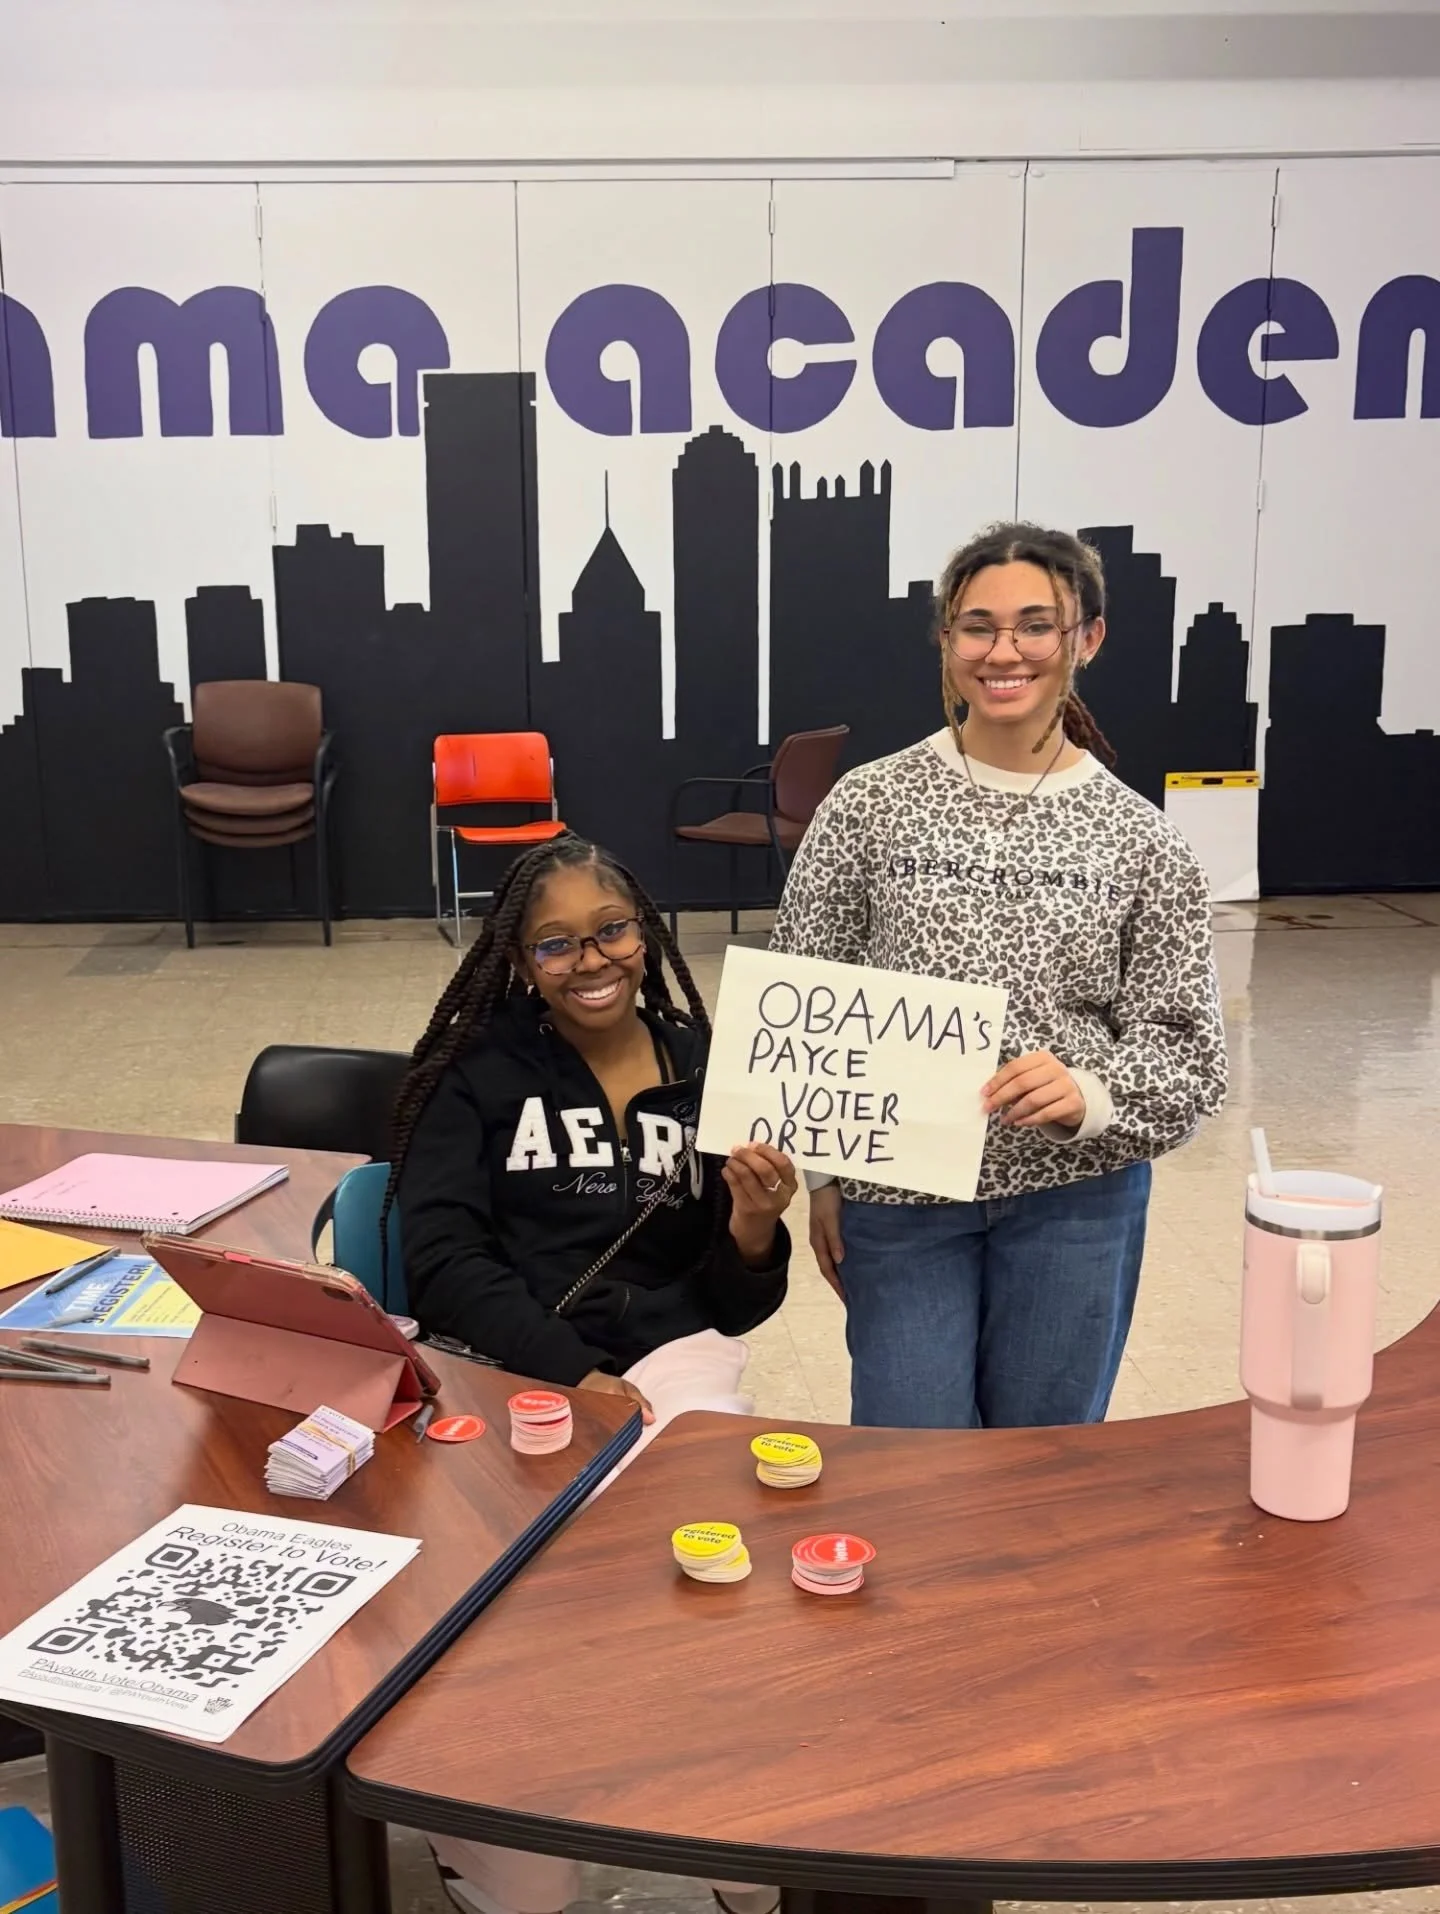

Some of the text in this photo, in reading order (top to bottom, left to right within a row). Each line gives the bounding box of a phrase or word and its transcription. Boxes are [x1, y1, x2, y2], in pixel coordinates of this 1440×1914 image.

[759, 981, 993, 1055] OBAMA's
[748, 1028, 869, 1079] PAYCE
[781, 1081, 900, 1126] VOTER
[749, 1117, 895, 1163] DRIVE
[553, 1171, 619, 1194] New
[759, 1436, 809, 1449] registered
[773, 1444, 795, 1452] vote
[221, 1522, 353, 1551] Obama Eagles
[679, 1528, 736, 1540] registered
[697, 1536, 722, 1544] vote
[166, 1526, 388, 1573] Register to Vote!
